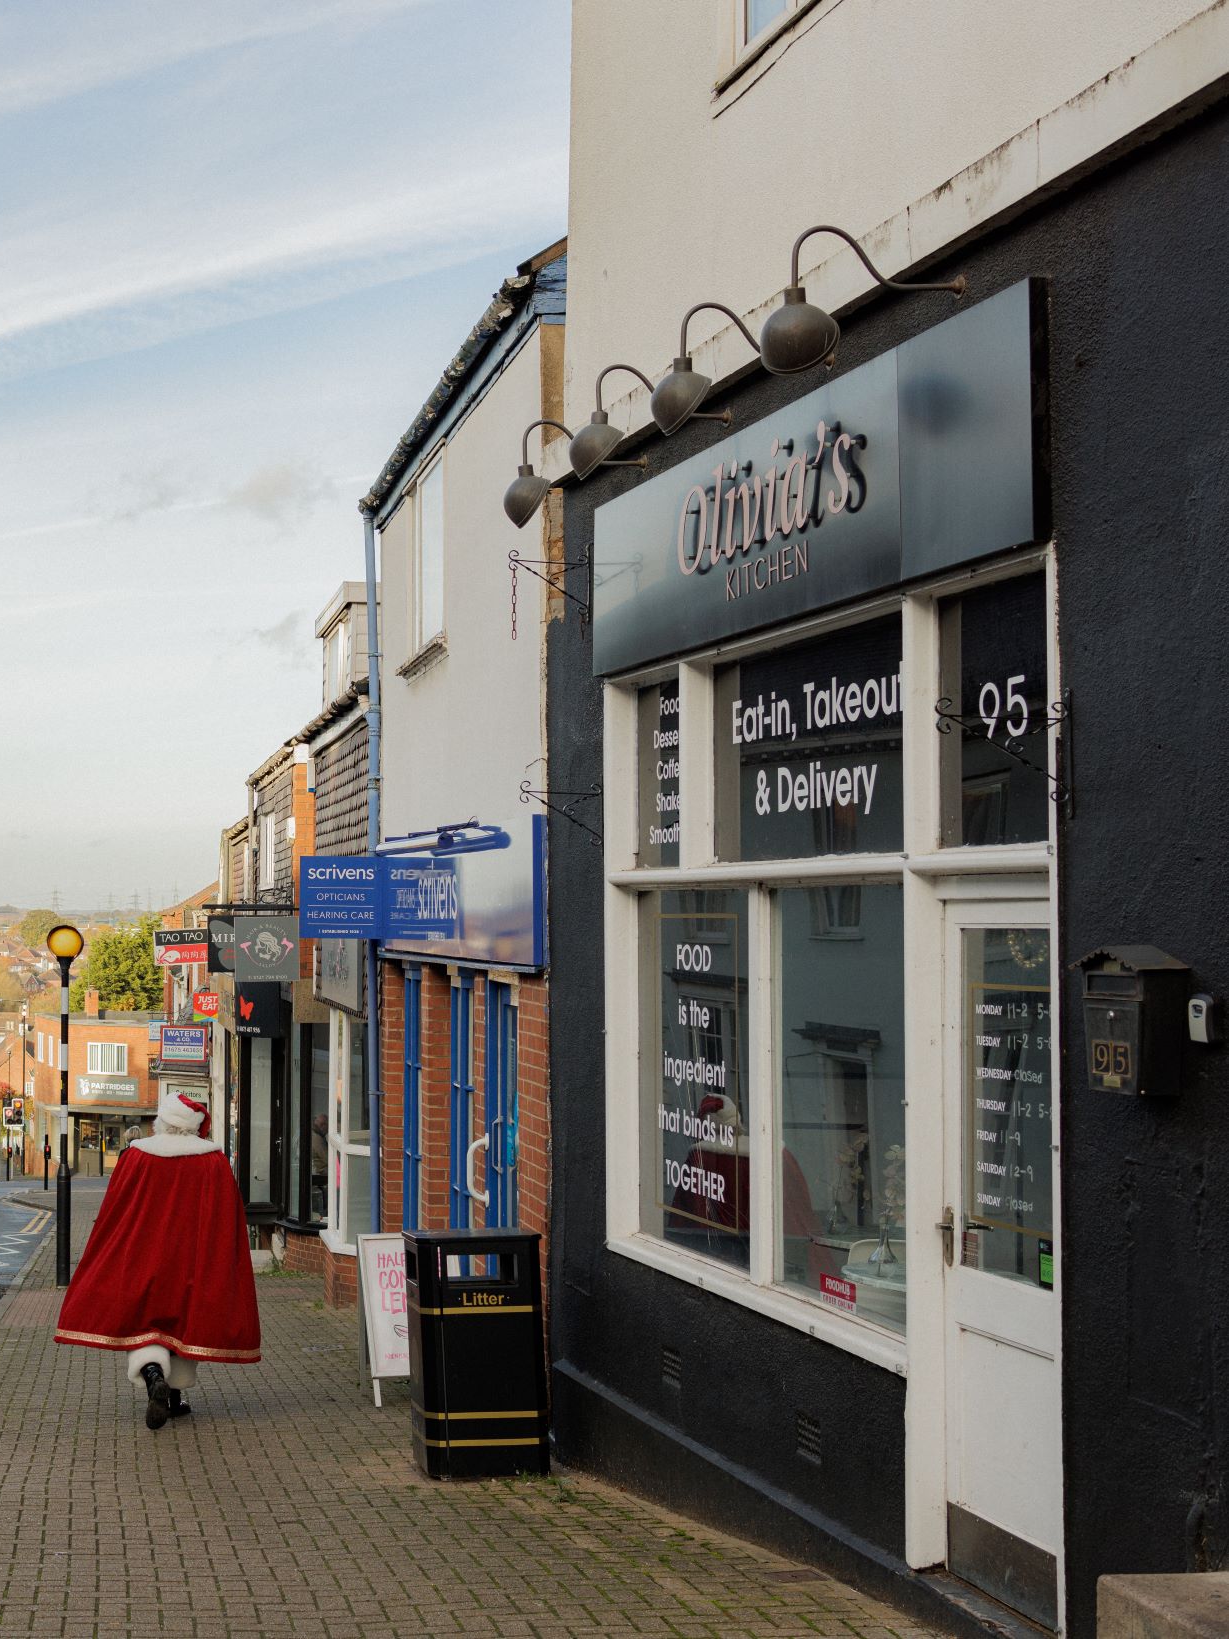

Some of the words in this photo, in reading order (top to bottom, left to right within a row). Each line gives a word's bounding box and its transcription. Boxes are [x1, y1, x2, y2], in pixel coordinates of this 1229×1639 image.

[677, 420, 850, 576] Olivia's
[726, 540, 809, 602] KITCHEN
[978, 674, 1028, 740] 95
[732, 691, 797, 745] Eat-in,
[653, 729, 679, 749] Desse
[755, 769, 771, 816] &
[777, 761, 878, 815] Delivery
[307, 864, 374, 880] scrivens
[316, 893, 366, 901] OPTICIANS
[418, 875, 458, 920] scrivens
[307, 911, 348, 919] HEARING
[350, 912, 375, 920] CARE
[159, 933, 180, 943] TAO
[182, 931, 204, 941] TAO
[676, 943, 712, 972] FOOD
[197, 995, 218, 1004] JUST
[201, 1003, 218, 1011] EAT
[678, 999, 687, 1026] is
[689, 1000, 710, 1029] the
[975, 1003, 1003, 1016] MONDAY
[1007, 1003, 1028, 1019] 11-2
[1037, 1003, 1051, 1020] 5-
[167, 1030, 201, 1038] WATERS
[975, 1035, 1001, 1048] TUESDAY
[1007, 1033, 1029, 1051] 11-2
[1096, 1045, 1126, 1073] 95
[664, 1051, 726, 1087] ingredient
[975, 1067, 1012, 1080] WEDNESDAY
[91, 1082, 135, 1091] PARTRIDGES
[976, 1098, 1006, 1112] THURSDAY
[1013, 1100, 1031, 1118] 11-2
[1038, 1103, 1052, 1120] 5-
[658, 1103, 680, 1134] that
[683, 1109, 716, 1143] binds
[719, 1123, 734, 1148] us
[976, 1129, 997, 1143] FRIDAY
[1000, 1130, 1021, 1146] 11-9
[665, 1159, 725, 1203] TOGETHER
[976, 1160, 1007, 1177] SATURDAY
[1010, 1163, 1033, 1183] 12-9
[976, 1192, 1001, 1207] SUNDAY
[825, 1277, 851, 1296] FOODHUB
[462, 1292, 505, 1306] Litter
